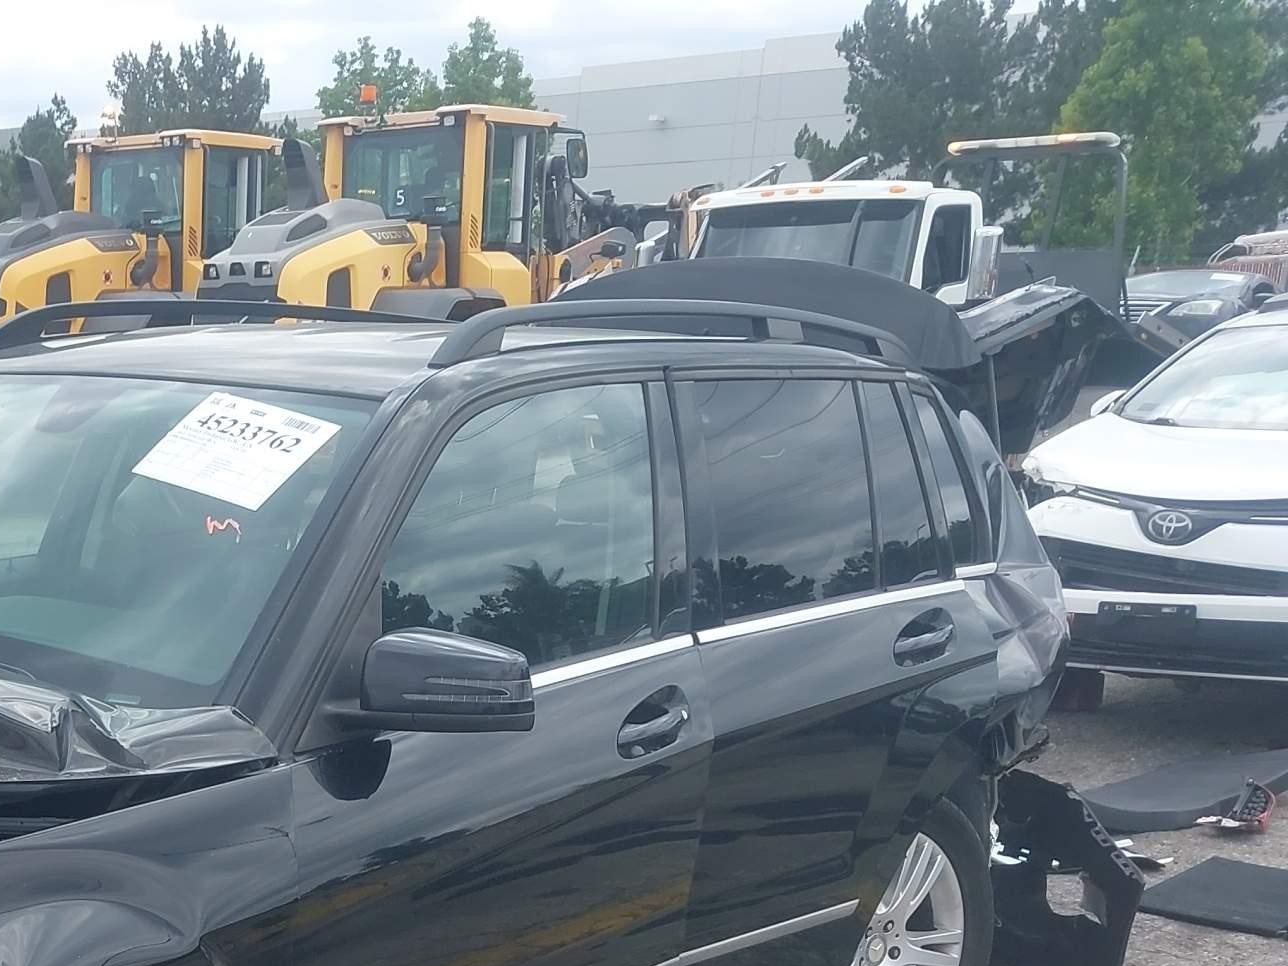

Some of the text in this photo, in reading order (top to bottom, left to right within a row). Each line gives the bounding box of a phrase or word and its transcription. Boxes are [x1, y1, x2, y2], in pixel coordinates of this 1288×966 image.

[395, 189, 405, 206] 5
[371, 230, 410, 241] VOLVO
[197, 412, 302, 453] 45233762
